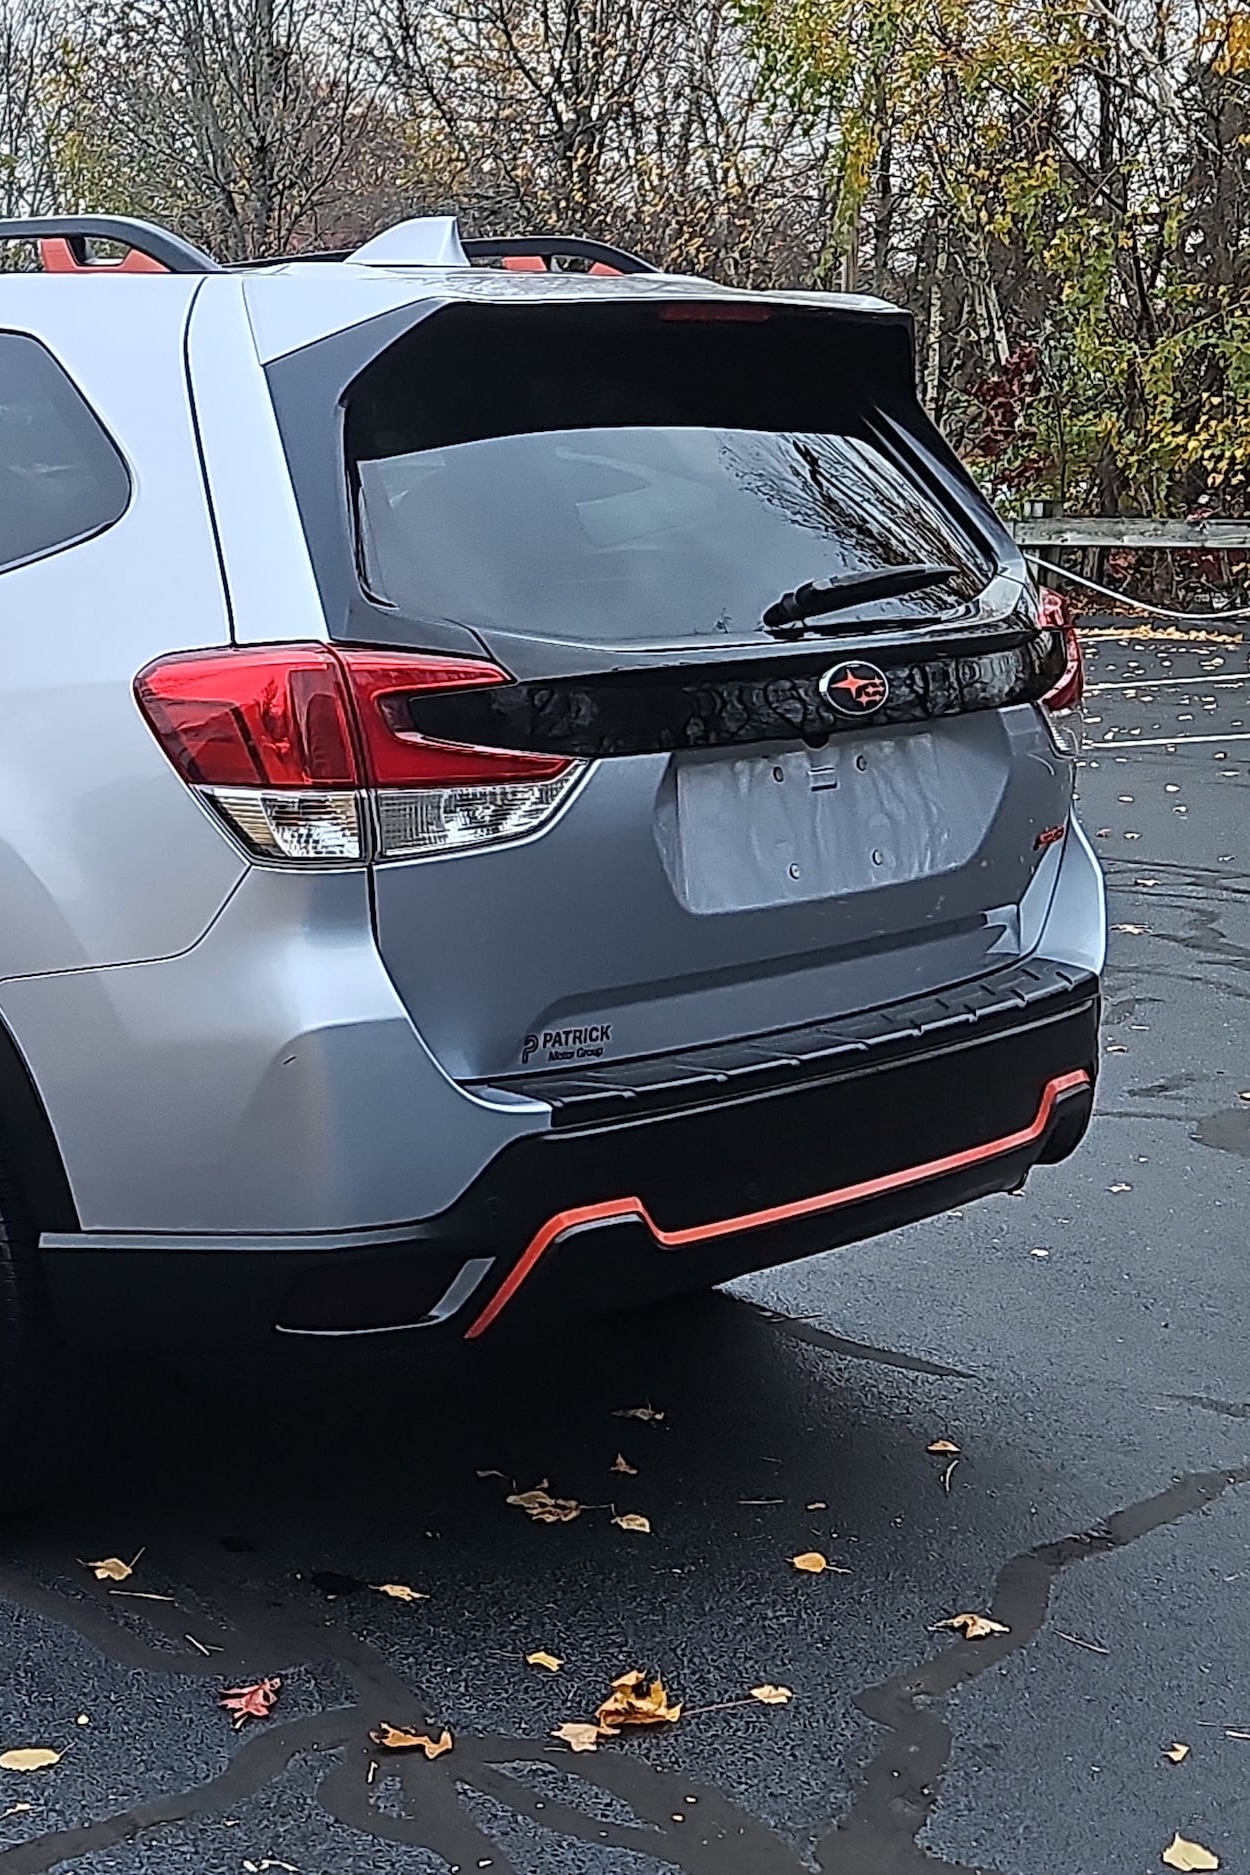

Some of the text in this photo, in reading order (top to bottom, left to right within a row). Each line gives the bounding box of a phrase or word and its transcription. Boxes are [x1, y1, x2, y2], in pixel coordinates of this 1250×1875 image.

[542, 1024, 612, 1049] PATRICK
[548, 1046, 604, 1061] Motor Group
